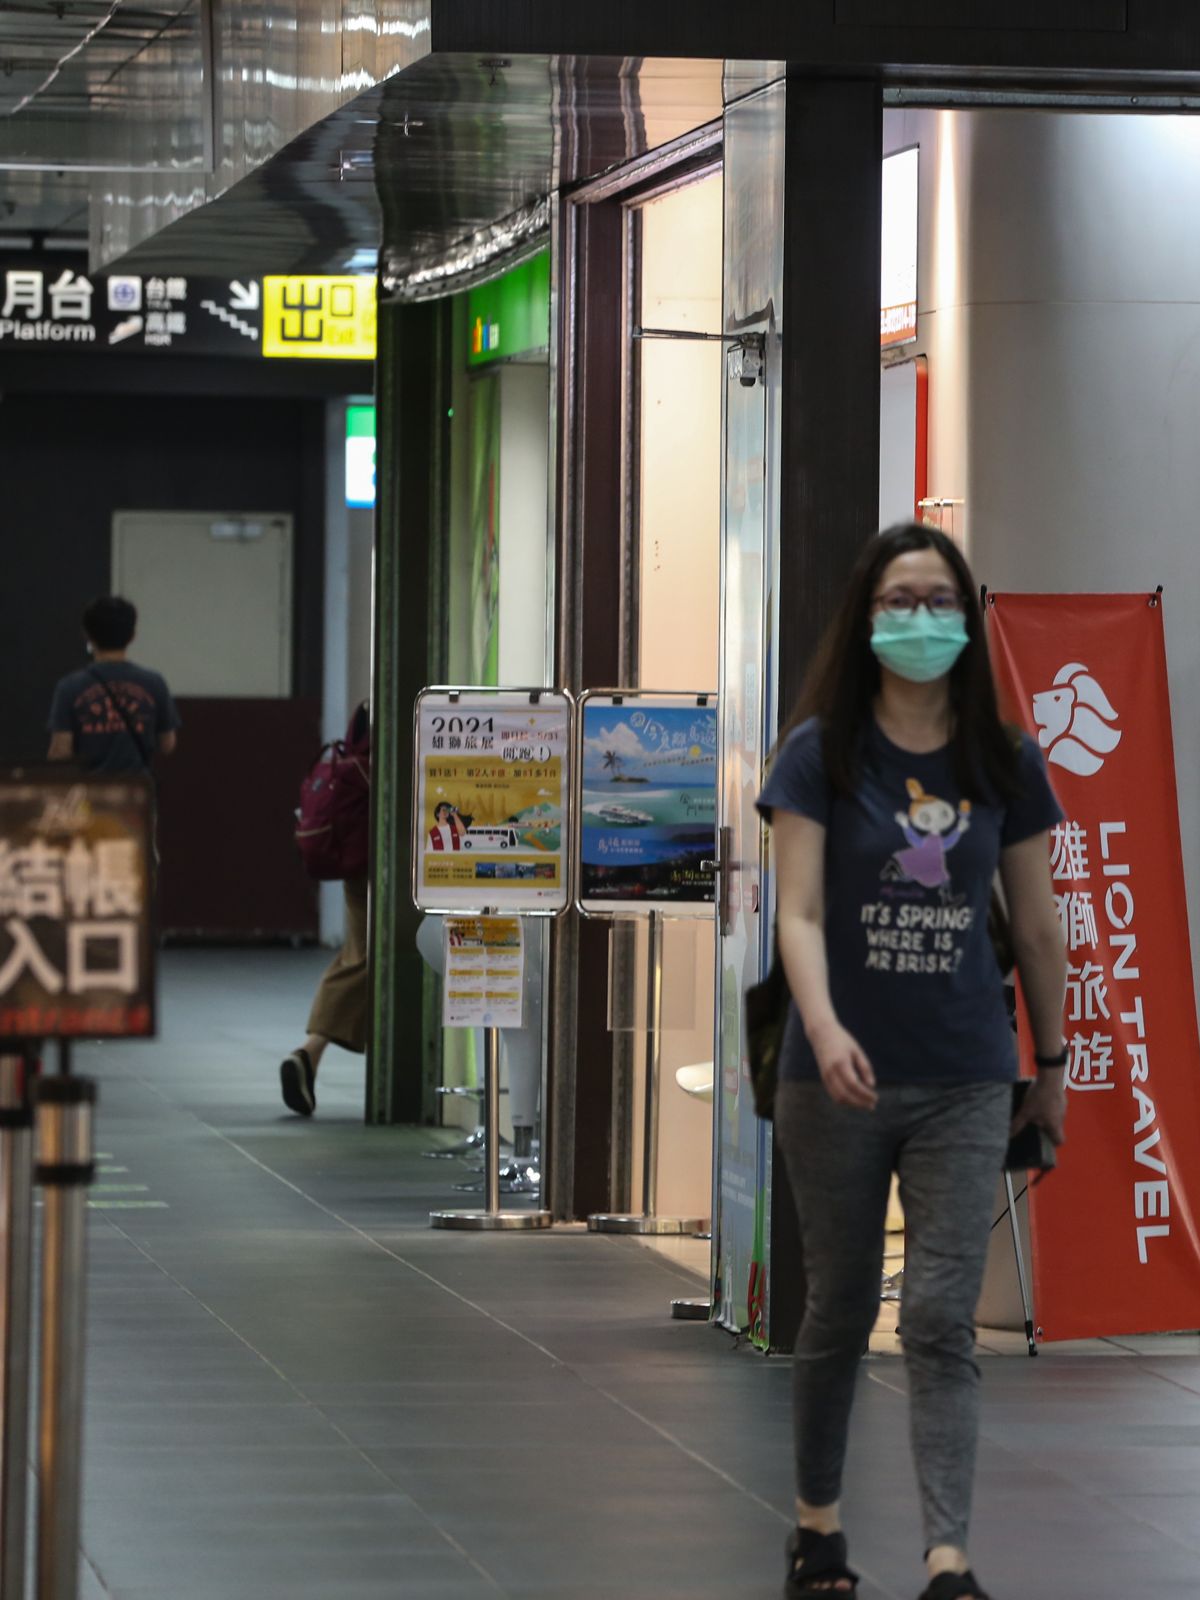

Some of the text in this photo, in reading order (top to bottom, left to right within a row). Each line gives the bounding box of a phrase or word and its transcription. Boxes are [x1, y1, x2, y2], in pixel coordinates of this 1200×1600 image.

[2, 269, 94, 321] 月台
[281, 283, 354, 342] 出口
[0, 320, 95, 341] Platform
[431, 716, 494, 733] 2021
[431, 735, 494, 750] 雄獅旅展
[861, 902, 892, 924] IT'S
[1099, 821, 1140, 980] LION
[0, 920, 140, 993] 入口
[934, 931, 953, 950] IS
[1050, 820, 1115, 1091] 雄獅旅遊
[1120, 996, 1170, 1263] TRAVEL
